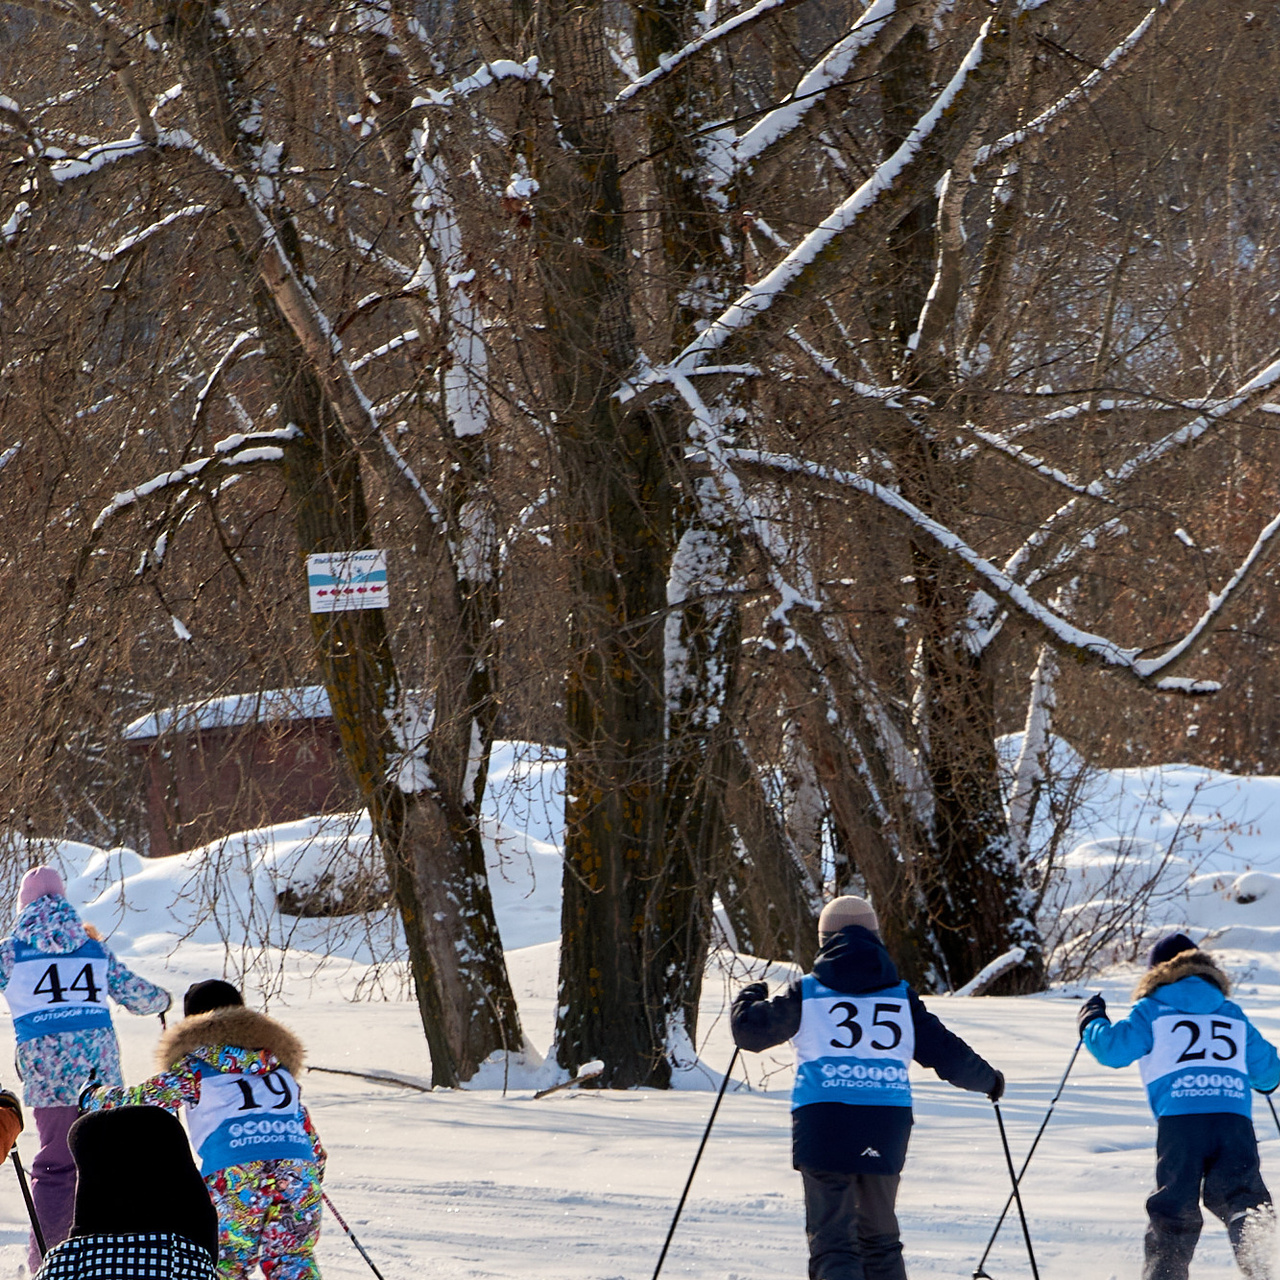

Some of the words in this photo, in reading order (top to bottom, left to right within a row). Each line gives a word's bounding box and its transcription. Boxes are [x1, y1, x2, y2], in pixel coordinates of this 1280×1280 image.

[33, 962, 102, 1004] 44
[828, 1001, 902, 1051] 35
[1171, 1020, 1238, 1064] 25
[228, 1071, 292, 1110] 19
[821, 1078, 882, 1088] OUTDOOR
[1170, 1088, 1221, 1098] OUTDOOR
[229, 1134, 286, 1148] OUTDOOR
